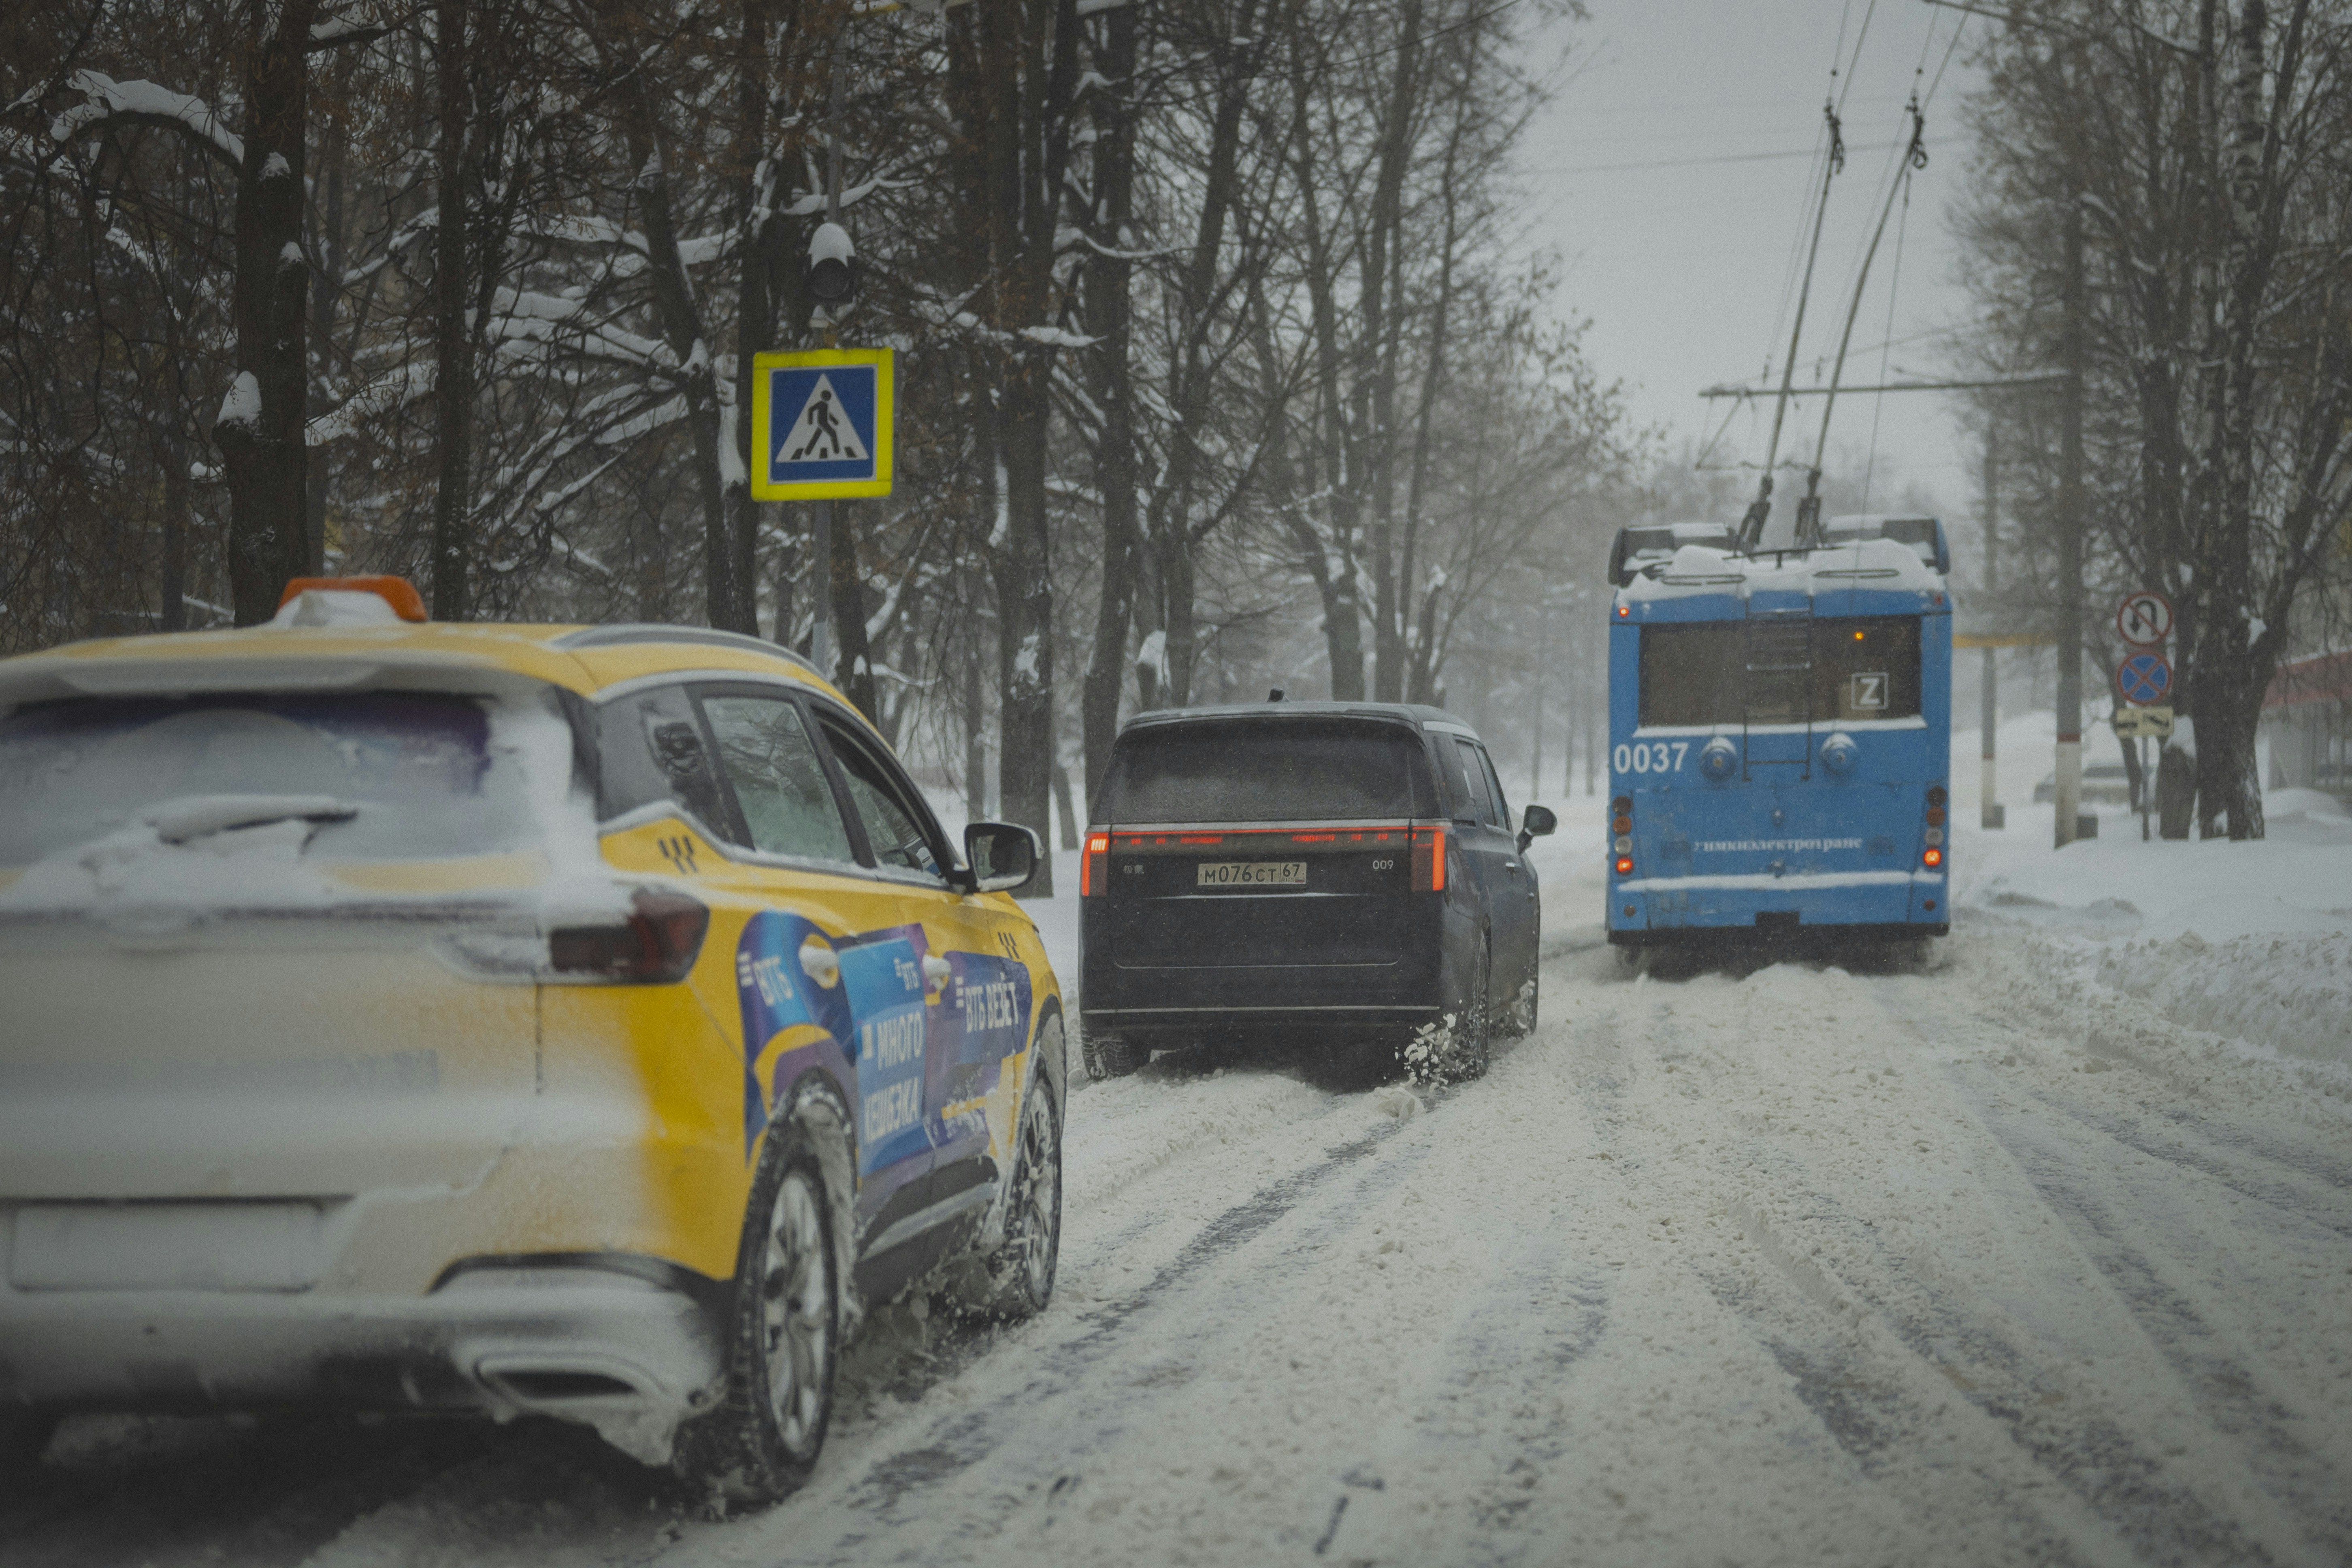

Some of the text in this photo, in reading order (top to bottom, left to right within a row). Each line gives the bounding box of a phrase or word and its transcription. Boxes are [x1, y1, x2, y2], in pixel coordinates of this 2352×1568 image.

[1860, 677, 1879, 704] Z
[1614, 742, 1689, 774] 0037
[1204, 864, 1300, 883] М076СТ 67
[1372, 860, 1393, 870] 009
[752, 955, 793, 1007] ВТБ
[901, 961, 919, 991] ВТБ
[965, 986, 985, 1033] ВТБ
[877, 1011, 922, 1070] МНОГО
